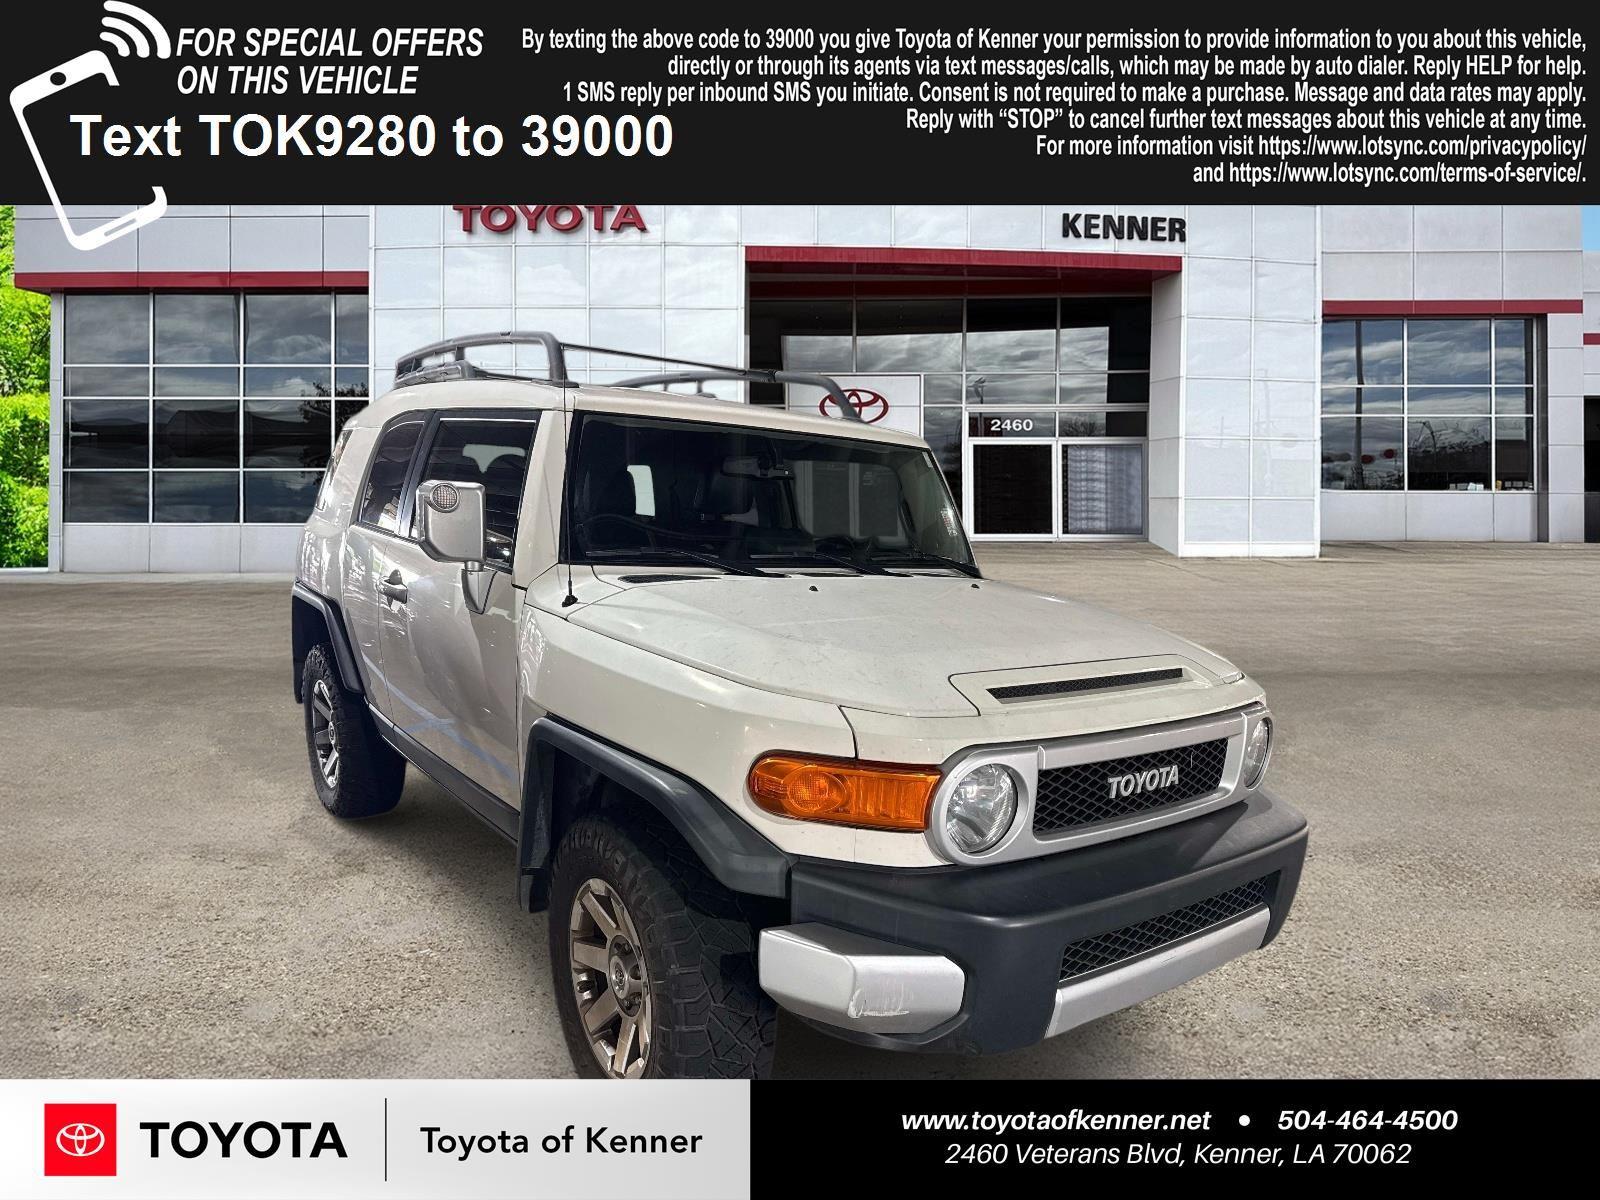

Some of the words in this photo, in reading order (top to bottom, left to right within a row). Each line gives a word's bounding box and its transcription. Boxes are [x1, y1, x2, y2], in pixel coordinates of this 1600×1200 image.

[452, 204, 647, 233] TOYOTA
[1062, 212, 1187, 242] KENNER
[990, 418, 1034, 432] 2460
[1107, 764, 1179, 799] TOYOTA
